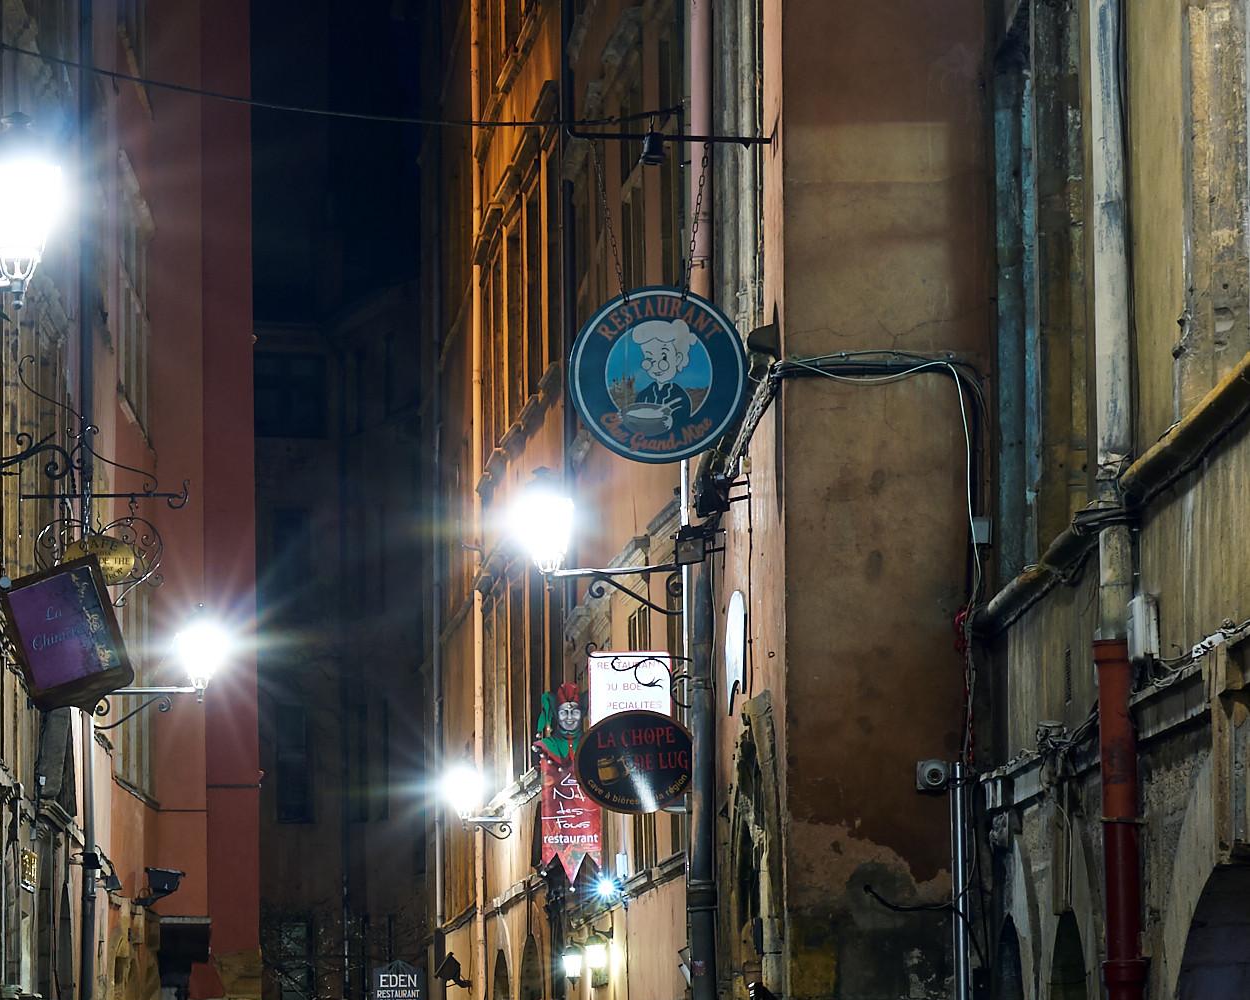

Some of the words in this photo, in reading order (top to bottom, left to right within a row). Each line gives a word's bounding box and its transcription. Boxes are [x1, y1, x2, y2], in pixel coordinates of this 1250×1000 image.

[596, 295, 723, 342] RESTAURANT
[597, 661, 660, 670] RETAUAN
[597, 731, 616, 750] LA
[621, 726, 676, 748] CHOPE
[634, 752, 654, 770] DE
[658, 750, 688, 769] LUG
[588, 777, 604, 796] cave
[543, 833, 599, 844] restaurant
[379, 974, 417, 988] EDEN
[377, 989, 420, 999] RESTAURANT
